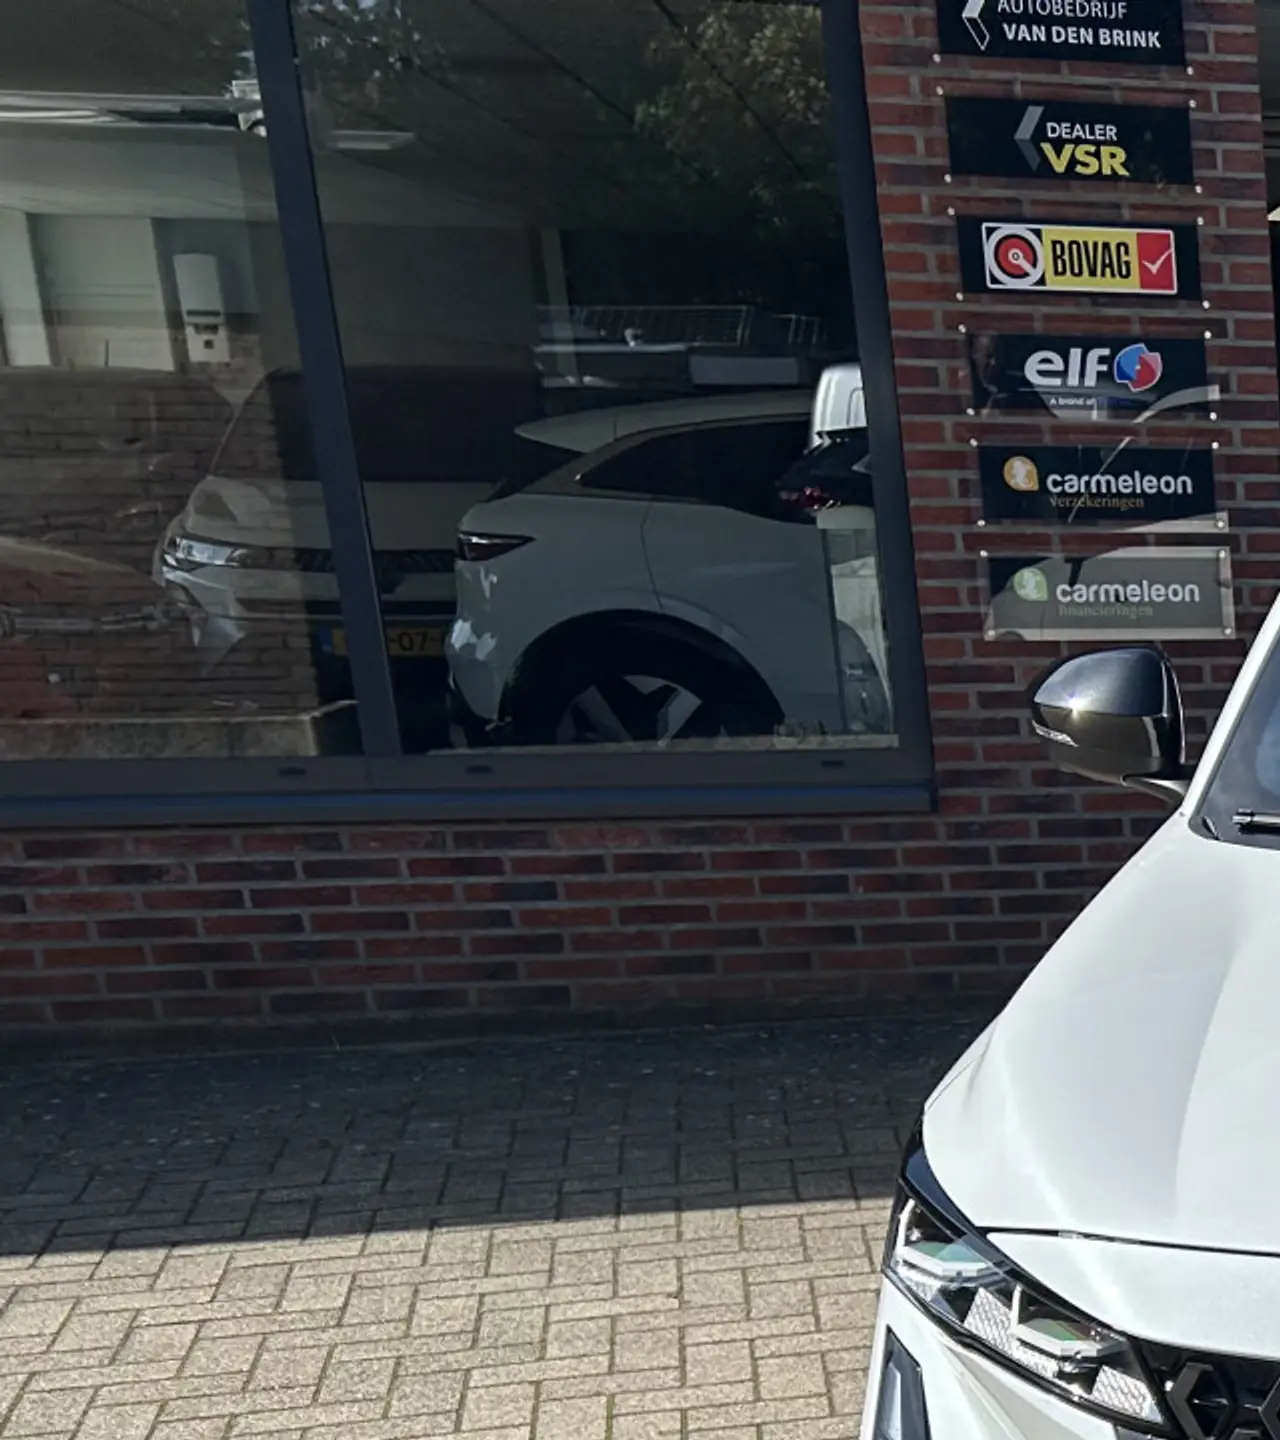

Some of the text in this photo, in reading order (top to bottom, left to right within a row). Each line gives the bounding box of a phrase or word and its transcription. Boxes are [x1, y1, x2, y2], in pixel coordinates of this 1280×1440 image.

[998, 0, 1128, 20] AUTOBEDRIJF
[1002, 22, 1162, 49] VAN DEN BRINK
[1046, 121, 1118, 142] DEALER
[1040, 142, 1130, 178] VSR
[1050, 239, 1132, 280] BOVAG
[1023, 347, 1110, 389] elf
[1045, 469, 1194, 496] carmeleon
[1055, 579, 1200, 604] carmeleon
